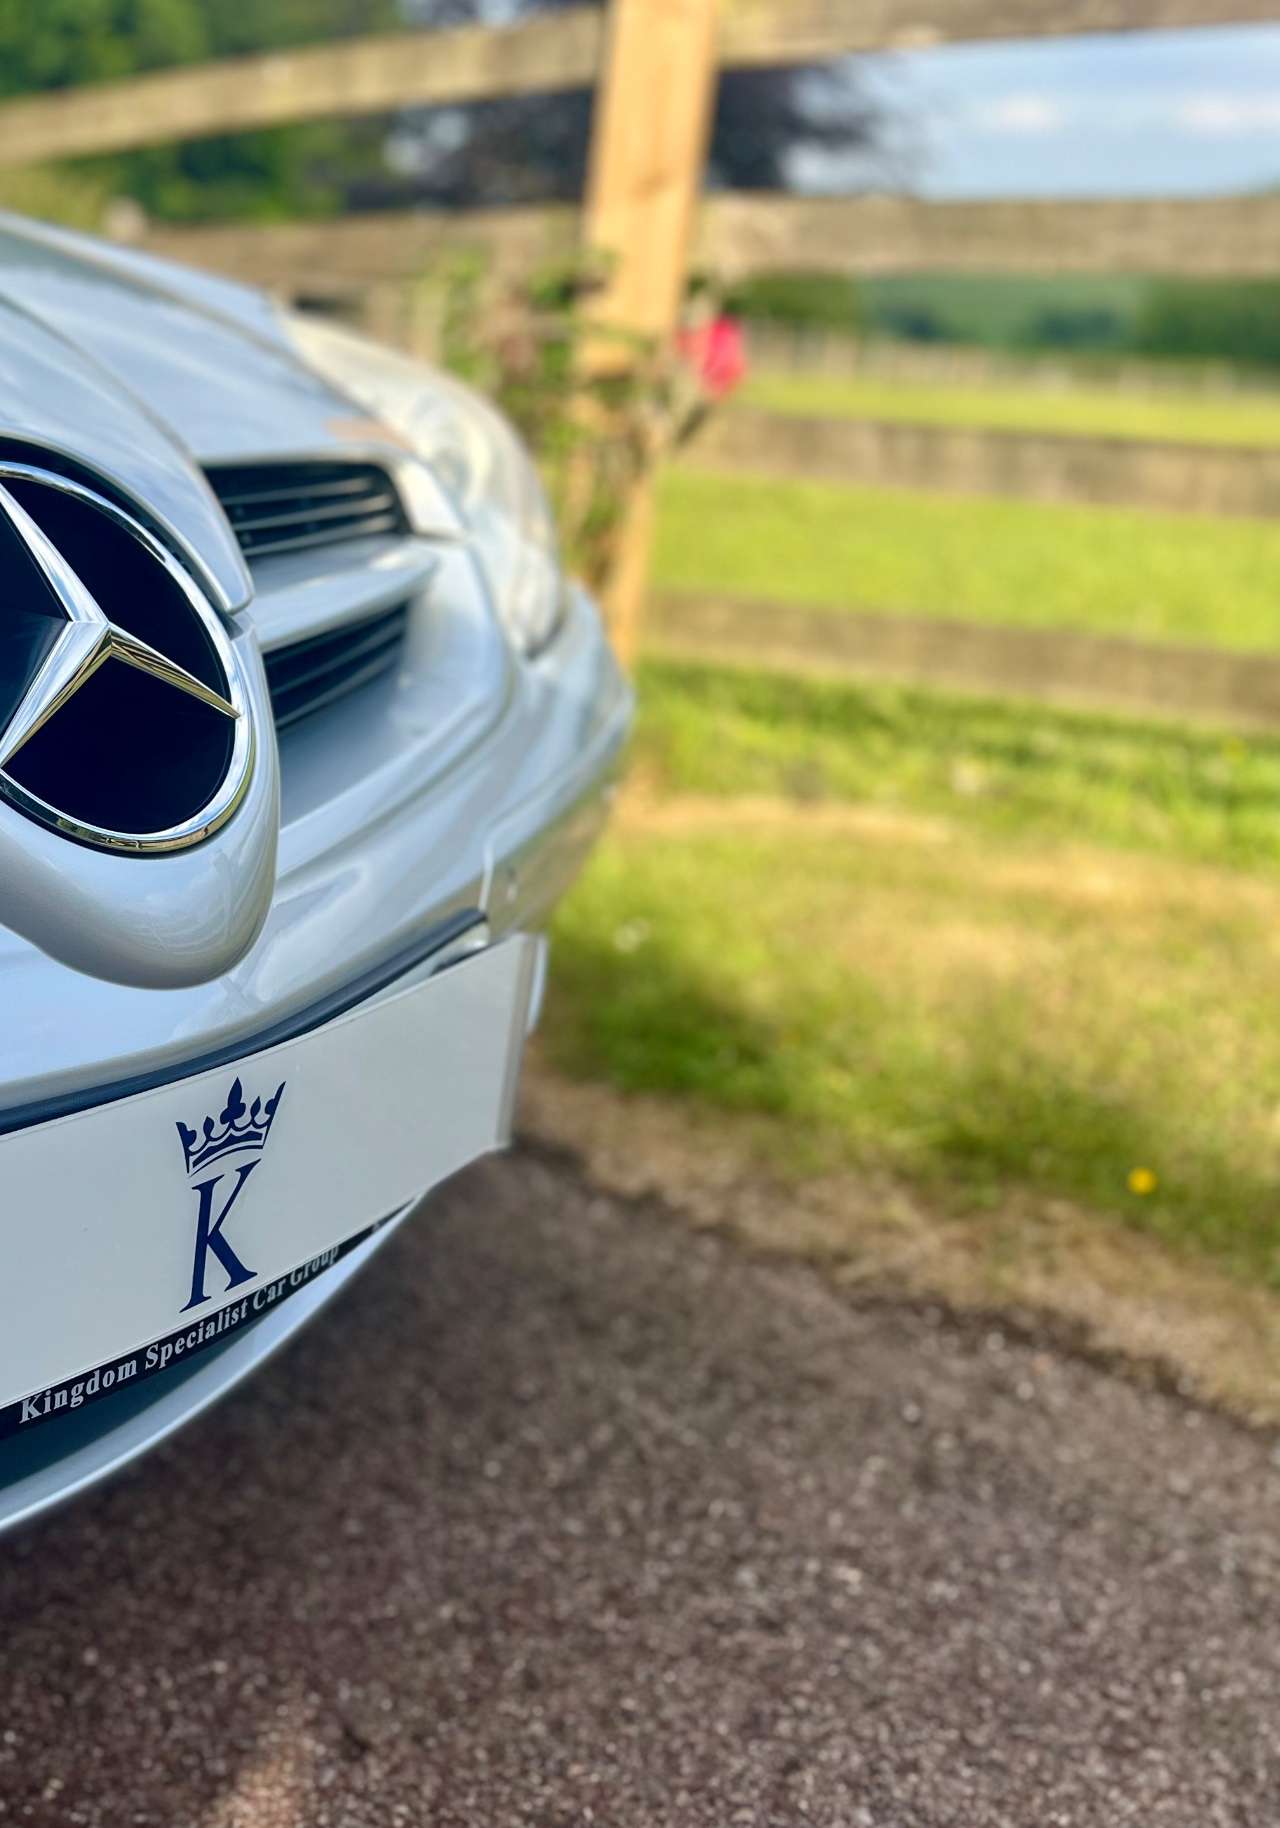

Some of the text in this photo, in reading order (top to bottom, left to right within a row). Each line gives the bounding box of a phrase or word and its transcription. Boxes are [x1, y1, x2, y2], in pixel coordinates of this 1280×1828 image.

[178, 1158, 260, 1313] K
[19, 1245, 340, 1424] Kingdom Specialist Car Group
